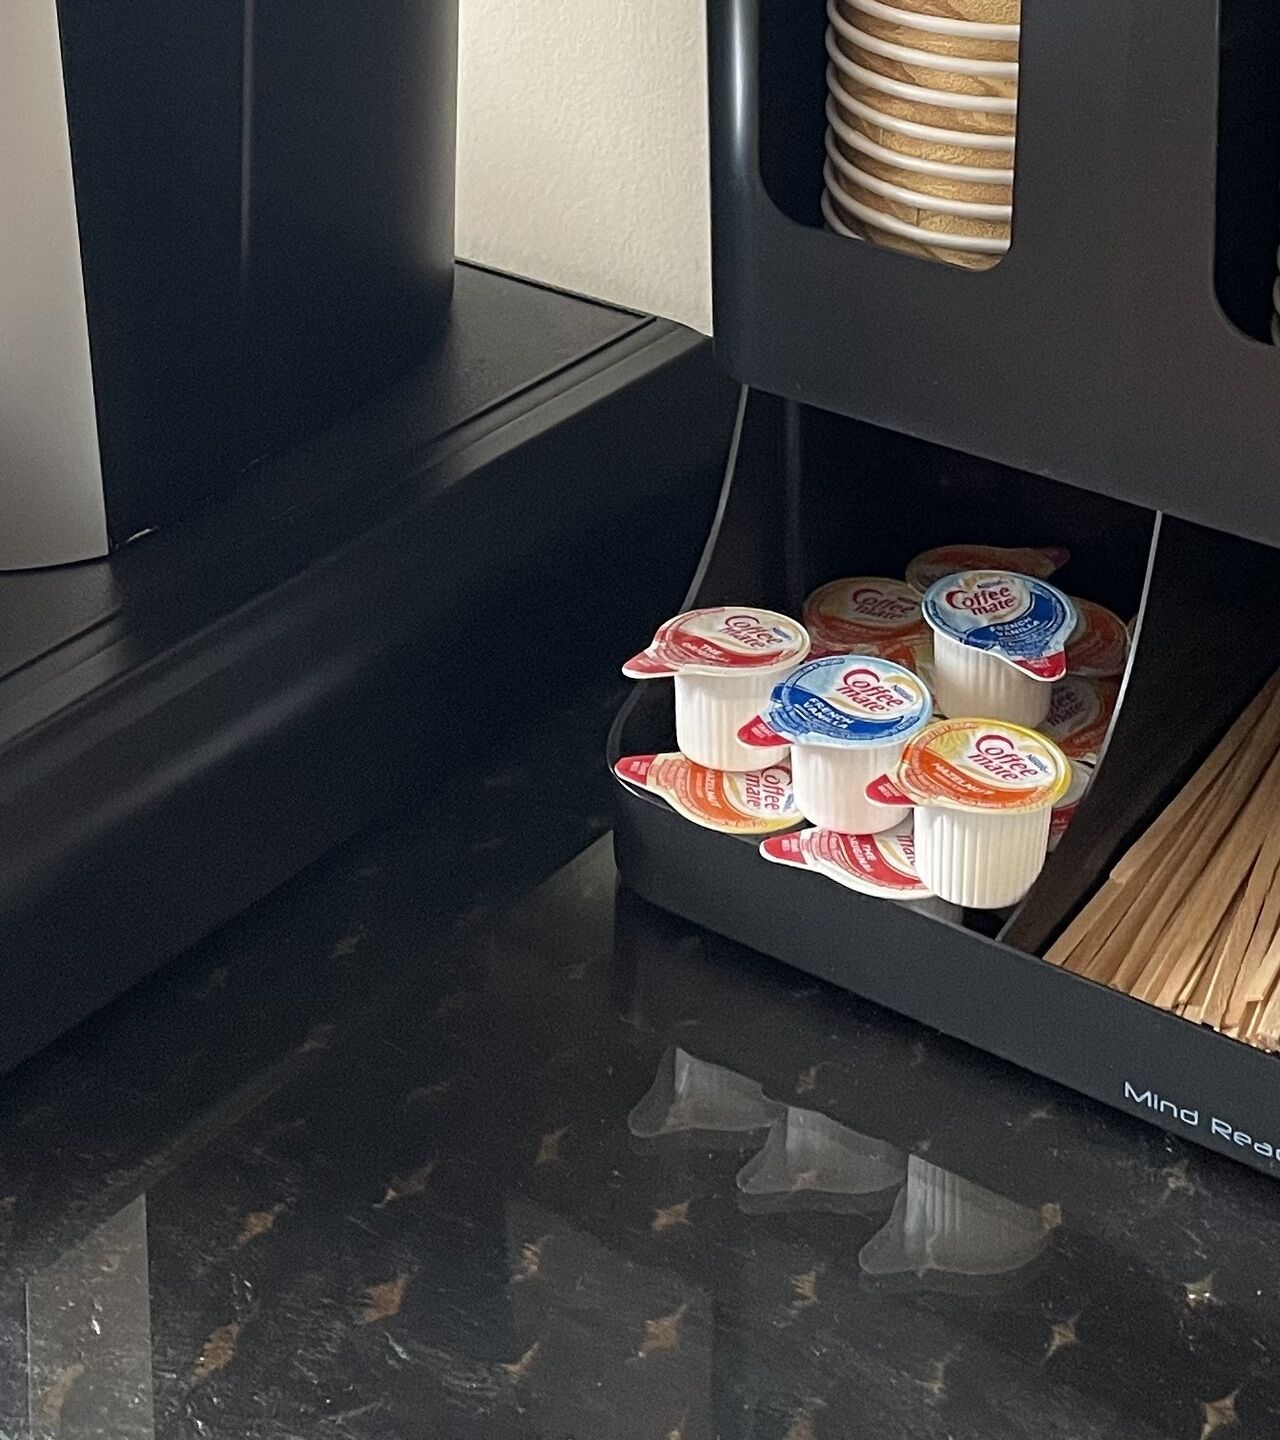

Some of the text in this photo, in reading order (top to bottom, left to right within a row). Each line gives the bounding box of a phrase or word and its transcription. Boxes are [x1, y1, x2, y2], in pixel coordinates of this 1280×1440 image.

[945, 586, 1012, 610] Coffee
[971, 597, 1015, 616] mate
[724, 615, 784, 647] Coffee
[835, 686, 886, 713] mate
[842, 668, 904, 707] Coffee
[808, 697, 856, 725] FRENCH
[967, 752, 1019, 783] mate
[975, 734, 1039, 779] Coffee
[745, 772, 762, 810] mate
[1123, 1081, 1200, 1126] Mind
